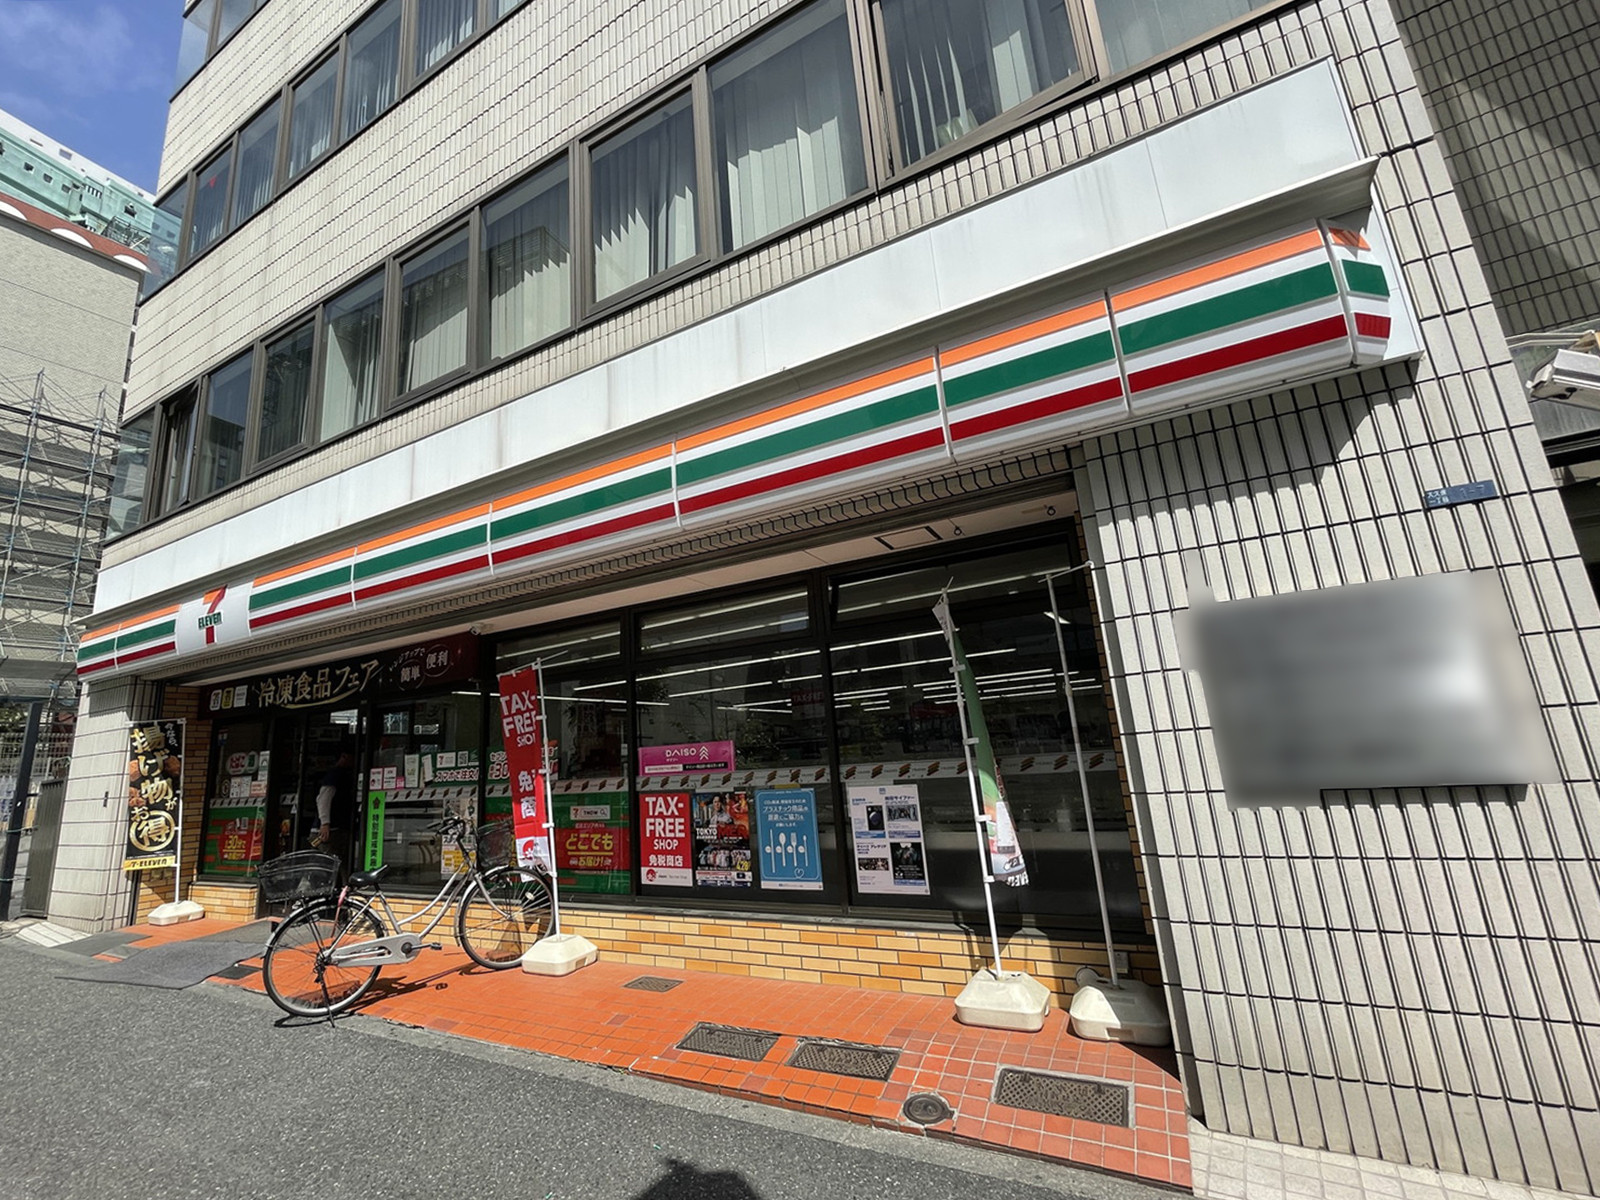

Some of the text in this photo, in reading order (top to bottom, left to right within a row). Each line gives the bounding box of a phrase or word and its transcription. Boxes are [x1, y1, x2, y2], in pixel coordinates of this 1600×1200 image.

[426, 649, 449, 670] 便利
[400, 664, 421, 683] 簡単
[258, 659, 380, 708] 冷凍食品フェア
[500, 689, 536, 716] TAX-
[516, 733, 536, 747] SHO
[665, 747, 697, 757] DAISO
[645, 796, 684, 816] TAX-
[645, 817, 686, 838] FREE
[695, 827, 718, 835] TOKYO
[565, 832, 614, 851] どこでも
[653, 839, 679, 850] SHOP
[649, 854, 684, 867] 免税商店
